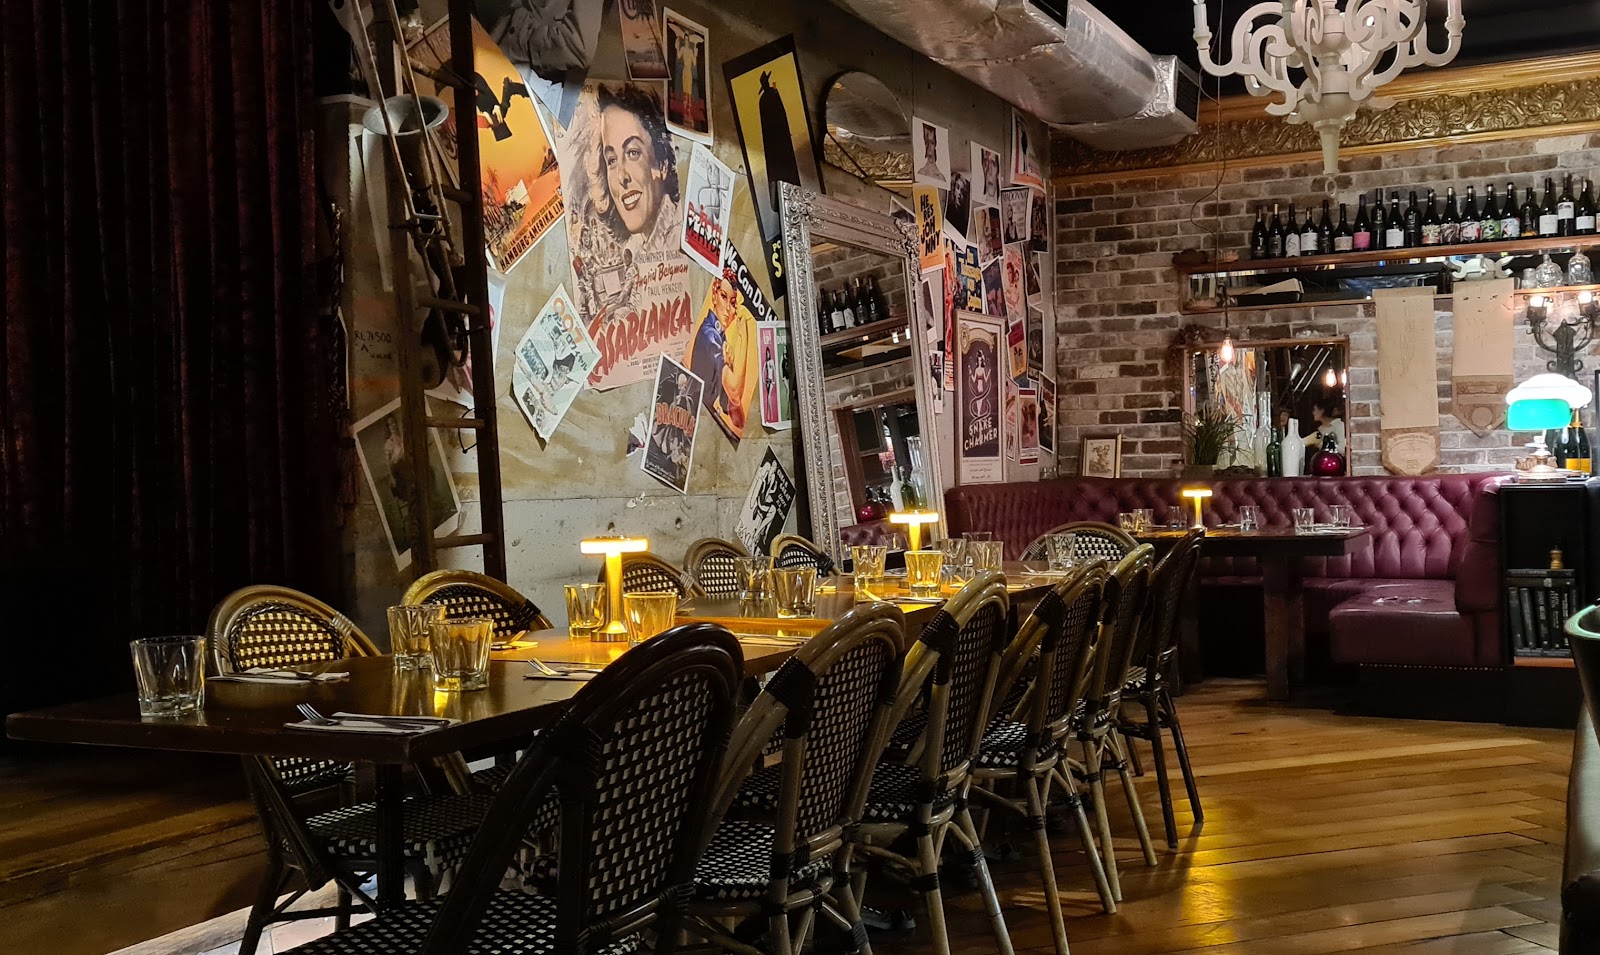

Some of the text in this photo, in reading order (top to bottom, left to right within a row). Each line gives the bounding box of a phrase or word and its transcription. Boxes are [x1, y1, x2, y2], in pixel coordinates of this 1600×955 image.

[634, 262, 688, 292] Ingrid Bergman
[648, 286, 661, 297] PAUL
[725, 240, 738, 272] We
[737, 264, 754, 300] Can
[753, 289, 765, 318] Do
[553, 297, 584, 344] 007
[587, 291, 693, 386] CASABLANCA
[656, 402, 695, 437] DRACULA
[968, 417, 992, 437] SNAKE
[964, 427, 998, 451] CHARMER
